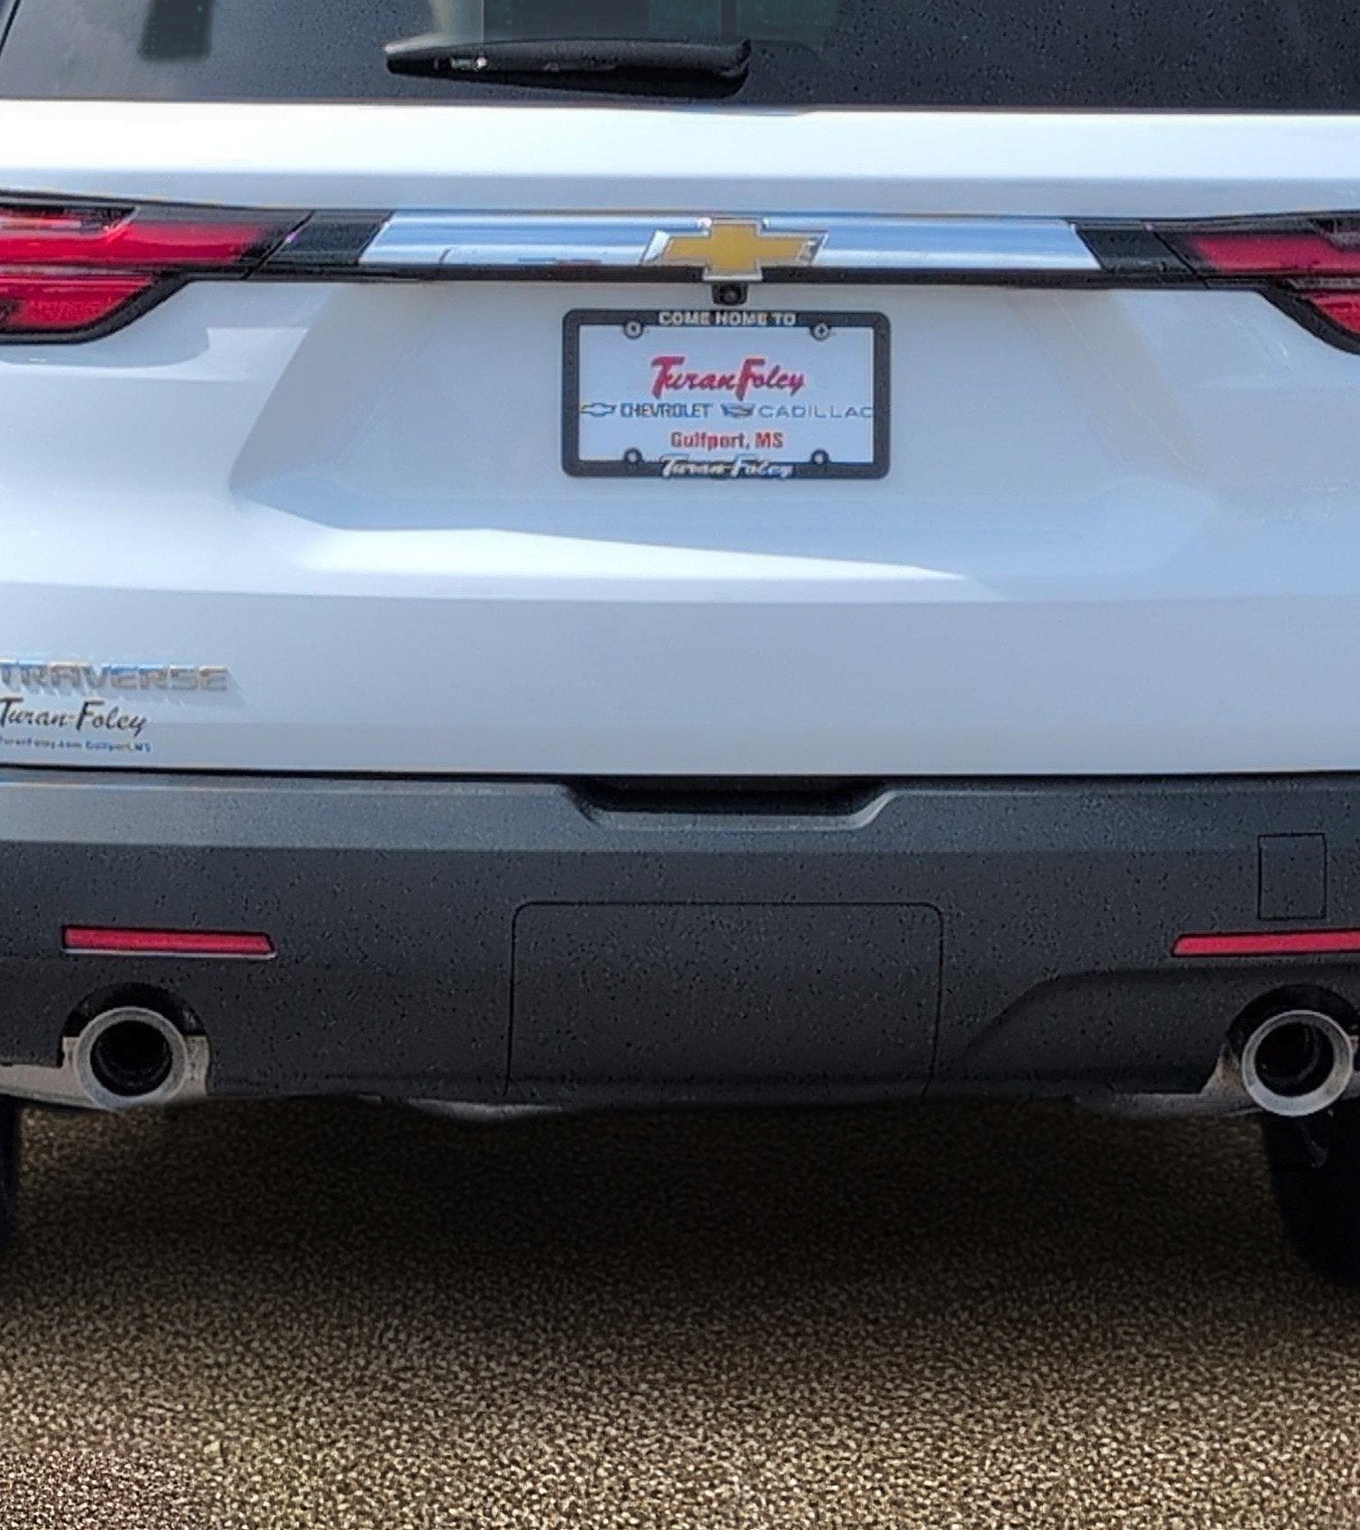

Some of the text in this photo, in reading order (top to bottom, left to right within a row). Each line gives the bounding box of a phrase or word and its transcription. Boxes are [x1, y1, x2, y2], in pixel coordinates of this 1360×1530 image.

[658, 311, 797, 327] COME HOME TO
[619, 401, 877, 419] CHEVROLET CADILLAC
[670, 431, 785, 451] Gulfport, MS
